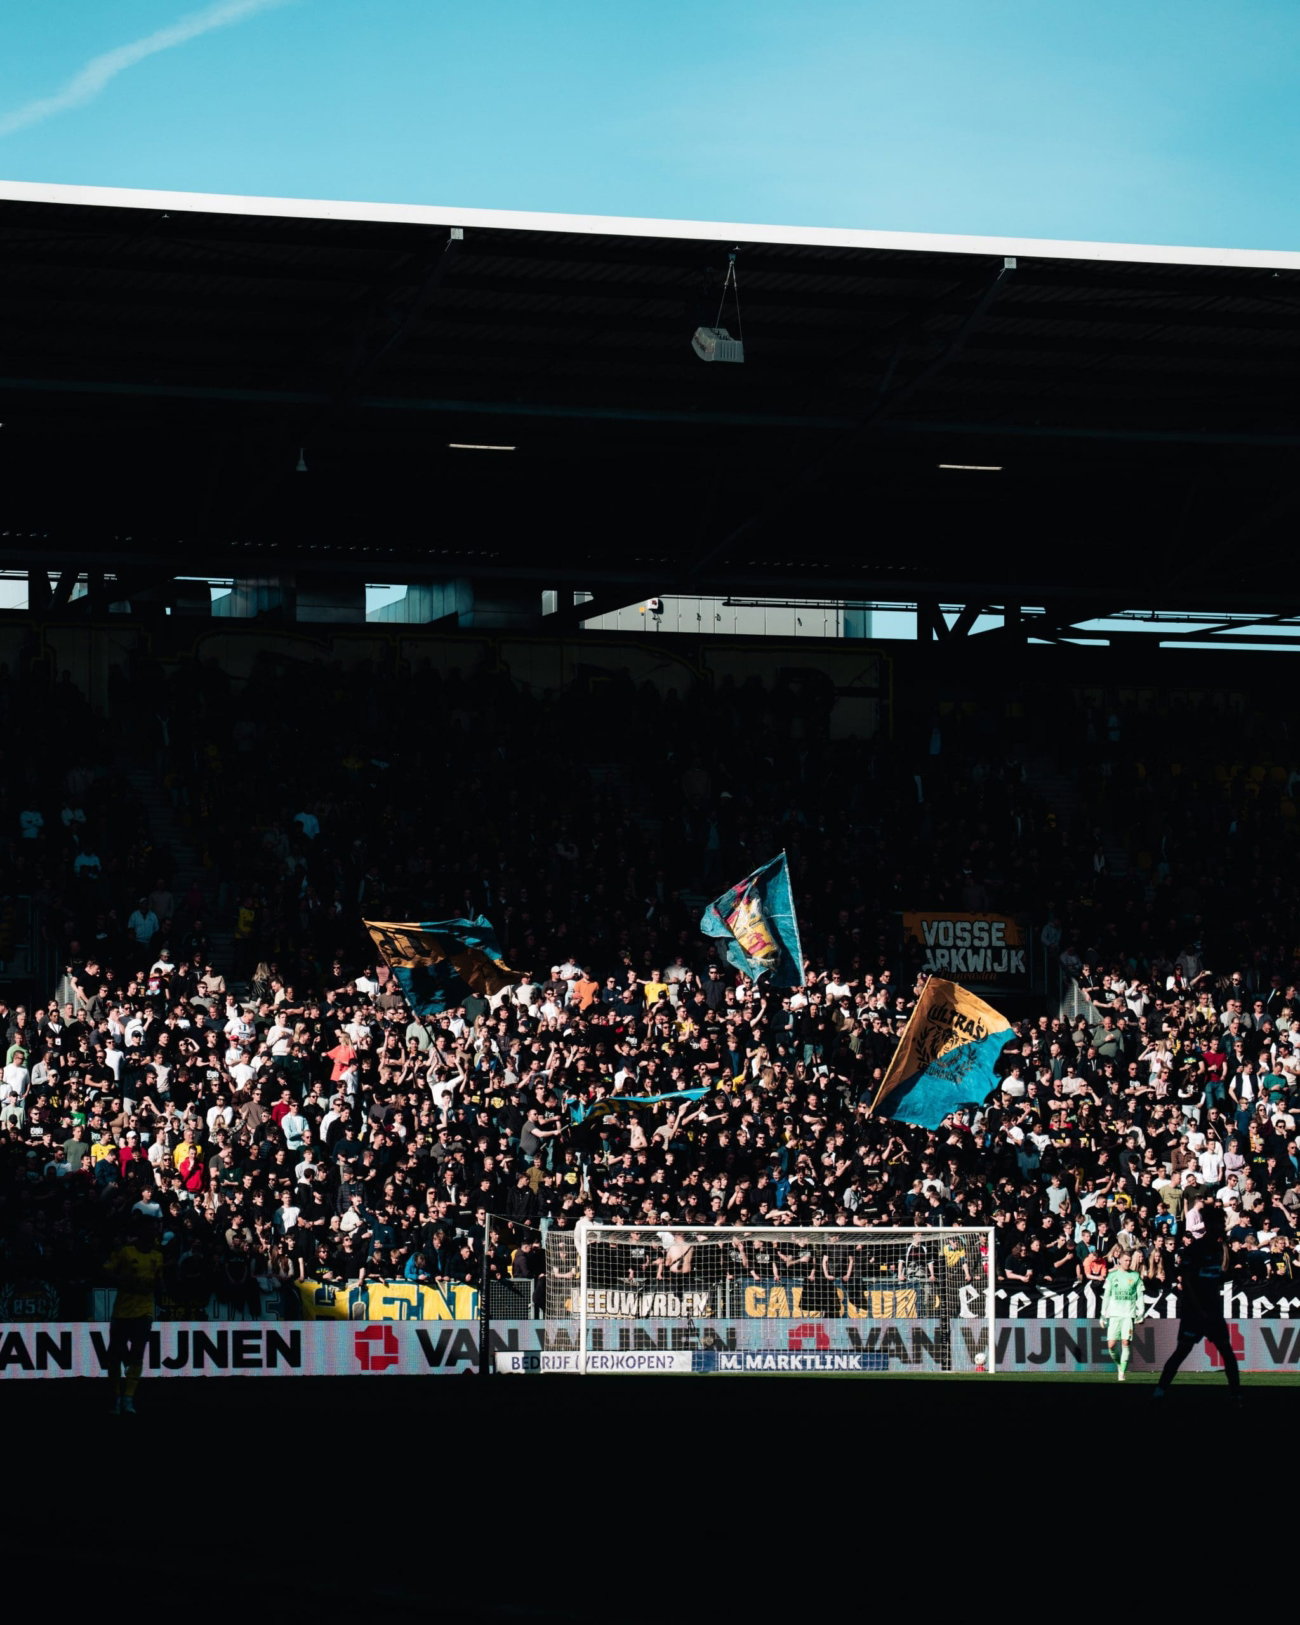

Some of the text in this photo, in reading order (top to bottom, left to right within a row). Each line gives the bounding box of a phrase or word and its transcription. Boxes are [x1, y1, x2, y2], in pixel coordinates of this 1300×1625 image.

[921, 920, 1006, 947] VOSSE
[928, 1002, 987, 1041] ULTRAS
[572, 1289, 709, 1318] LEEUWARDEN
[0, 1331, 71, 1370] AN
[511, 1355, 570, 1371] BEDRIJF
[746, 1354, 862, 1371] MARKTLINK
